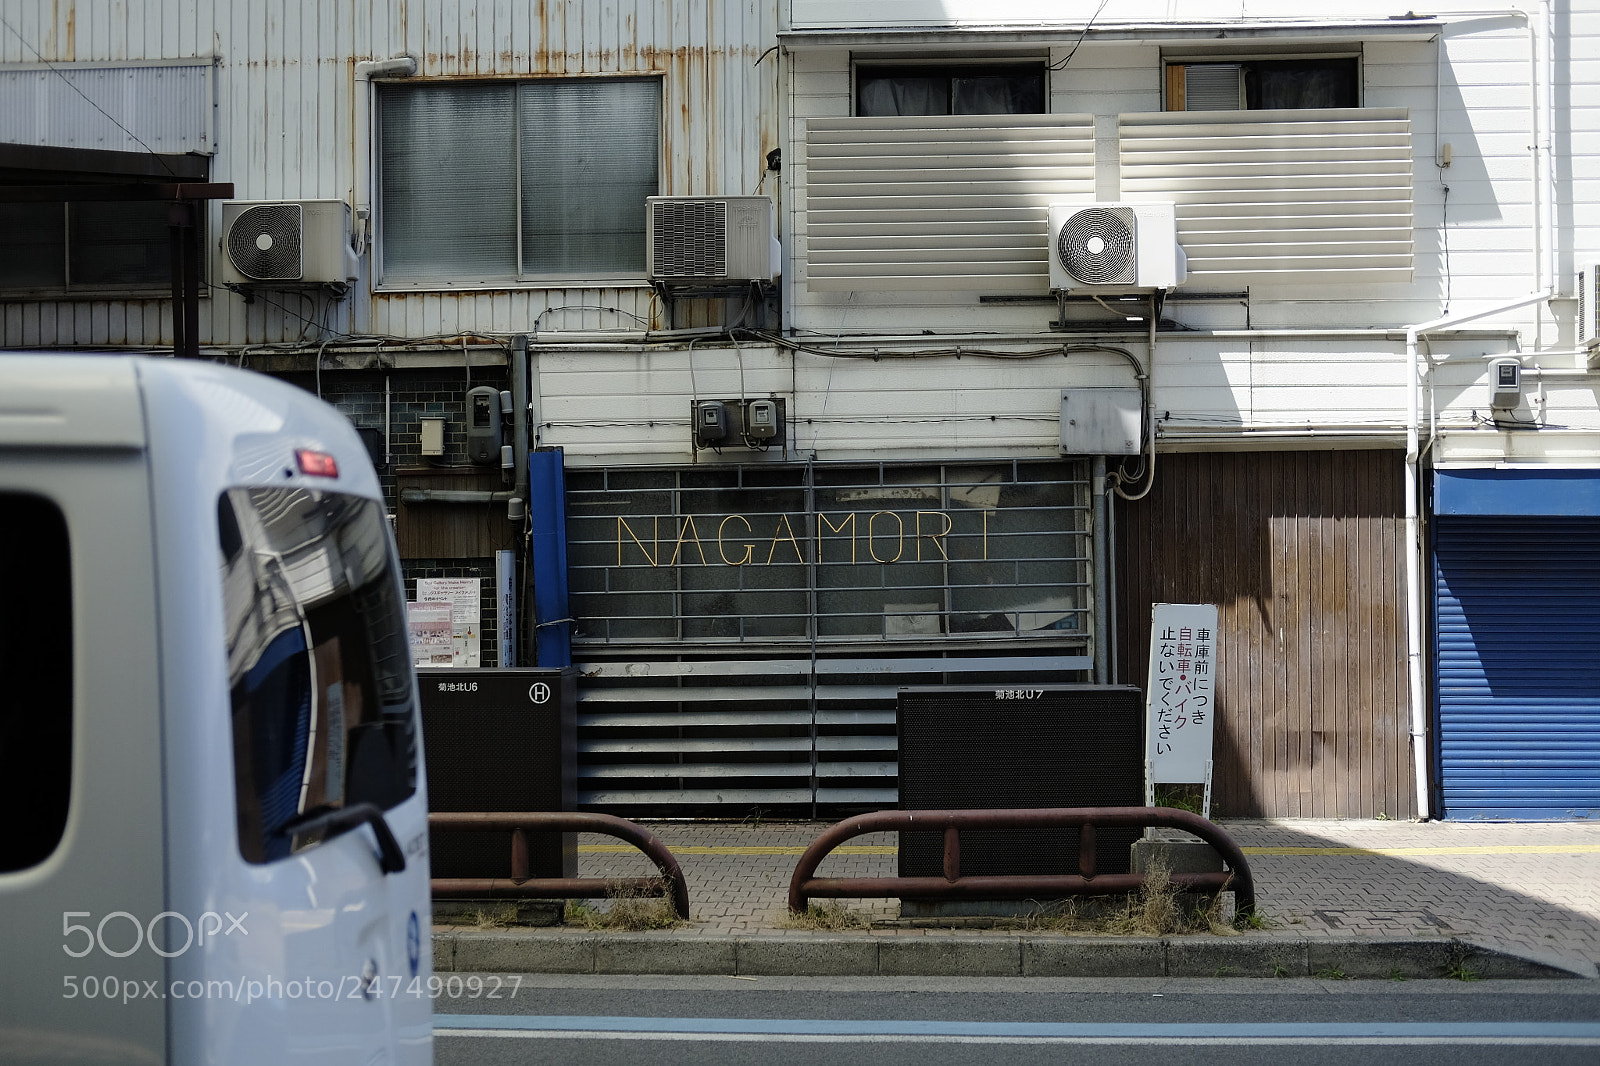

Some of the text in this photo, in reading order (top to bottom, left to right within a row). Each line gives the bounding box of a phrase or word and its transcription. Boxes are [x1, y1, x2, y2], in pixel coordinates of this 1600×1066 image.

[618, 510, 987, 568] NAGAMORI
[438, 682, 478, 692] 菊池北U6
[995, 689, 1044, 700] 菊池北U7
[1157, 626, 1176, 755] 止ないでください
[1191, 628, 1211, 725] 車庫前につき
